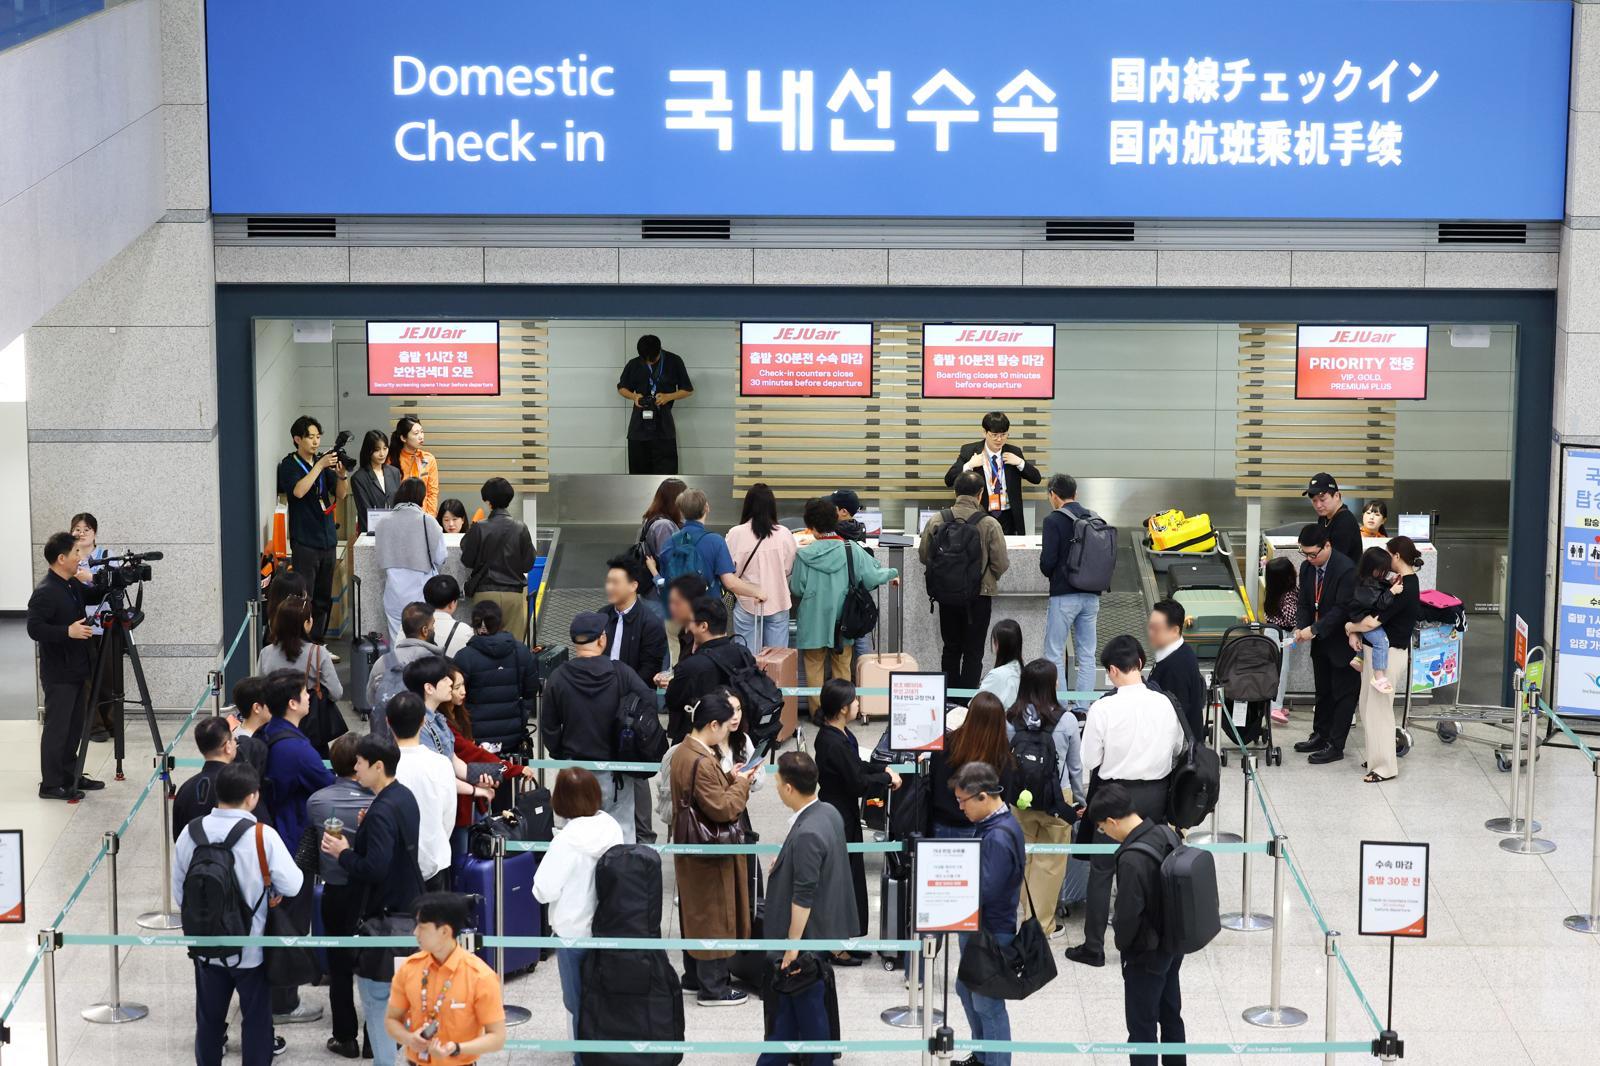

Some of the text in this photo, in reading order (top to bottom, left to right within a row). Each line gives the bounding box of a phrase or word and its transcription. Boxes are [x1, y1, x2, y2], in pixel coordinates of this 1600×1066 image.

[393, 53, 615, 97] Domestic
[1109, 56, 1440, 105] 国内線チェックイン
[664, 67, 1060, 153] 국내선수속
[394, 118, 605, 163] Check-in
[1109, 118, 1404, 168] 国内航班乘机手续
[398, 350, 468, 363] 출발 1시간 전
[750, 352, 863, 365] 출발 30분전 수속 마감
[933, 354, 1044, 367] 출발 10분전 탑승 마감
[1310, 357, 1415, 370] PRIORITY 전용
[394, 366, 474, 378] 보안검색대 오픈
[936, 372, 972, 380] Boarding
[794, 379, 820, 387] before
[824, 380, 862, 388] departure
[956, 380, 1022, 390] before departure
[1330, 382, 1392, 390] PREMIUM PLUS
[1376, 860, 1413, 870] 수속 마감
[1387, 876, 1408, 886] 30분
